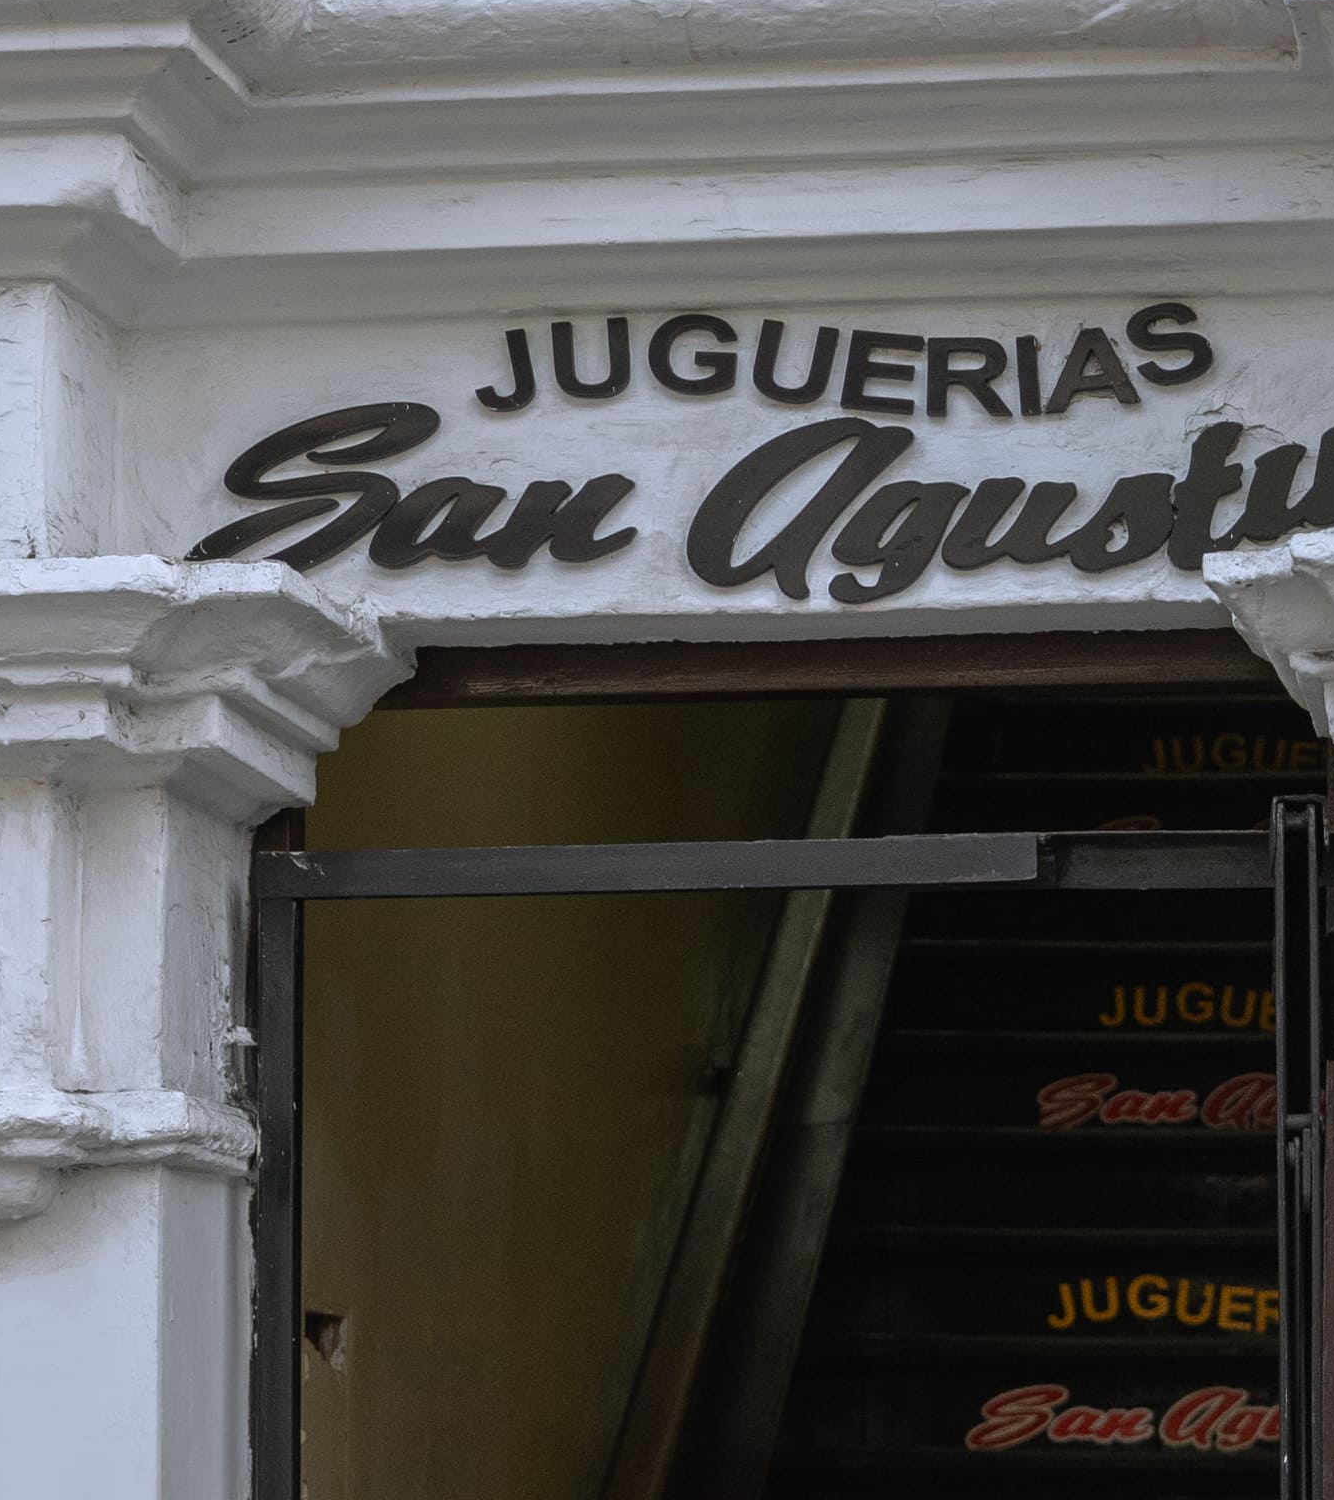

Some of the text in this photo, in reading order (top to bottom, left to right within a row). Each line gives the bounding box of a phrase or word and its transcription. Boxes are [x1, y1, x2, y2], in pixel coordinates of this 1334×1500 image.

[475, 303, 1214, 418] JUGUERIAS
[185, 401, 637, 571] San
[1037, 1072, 1198, 1130] San
[966, 1384, 1154, 1451] San
